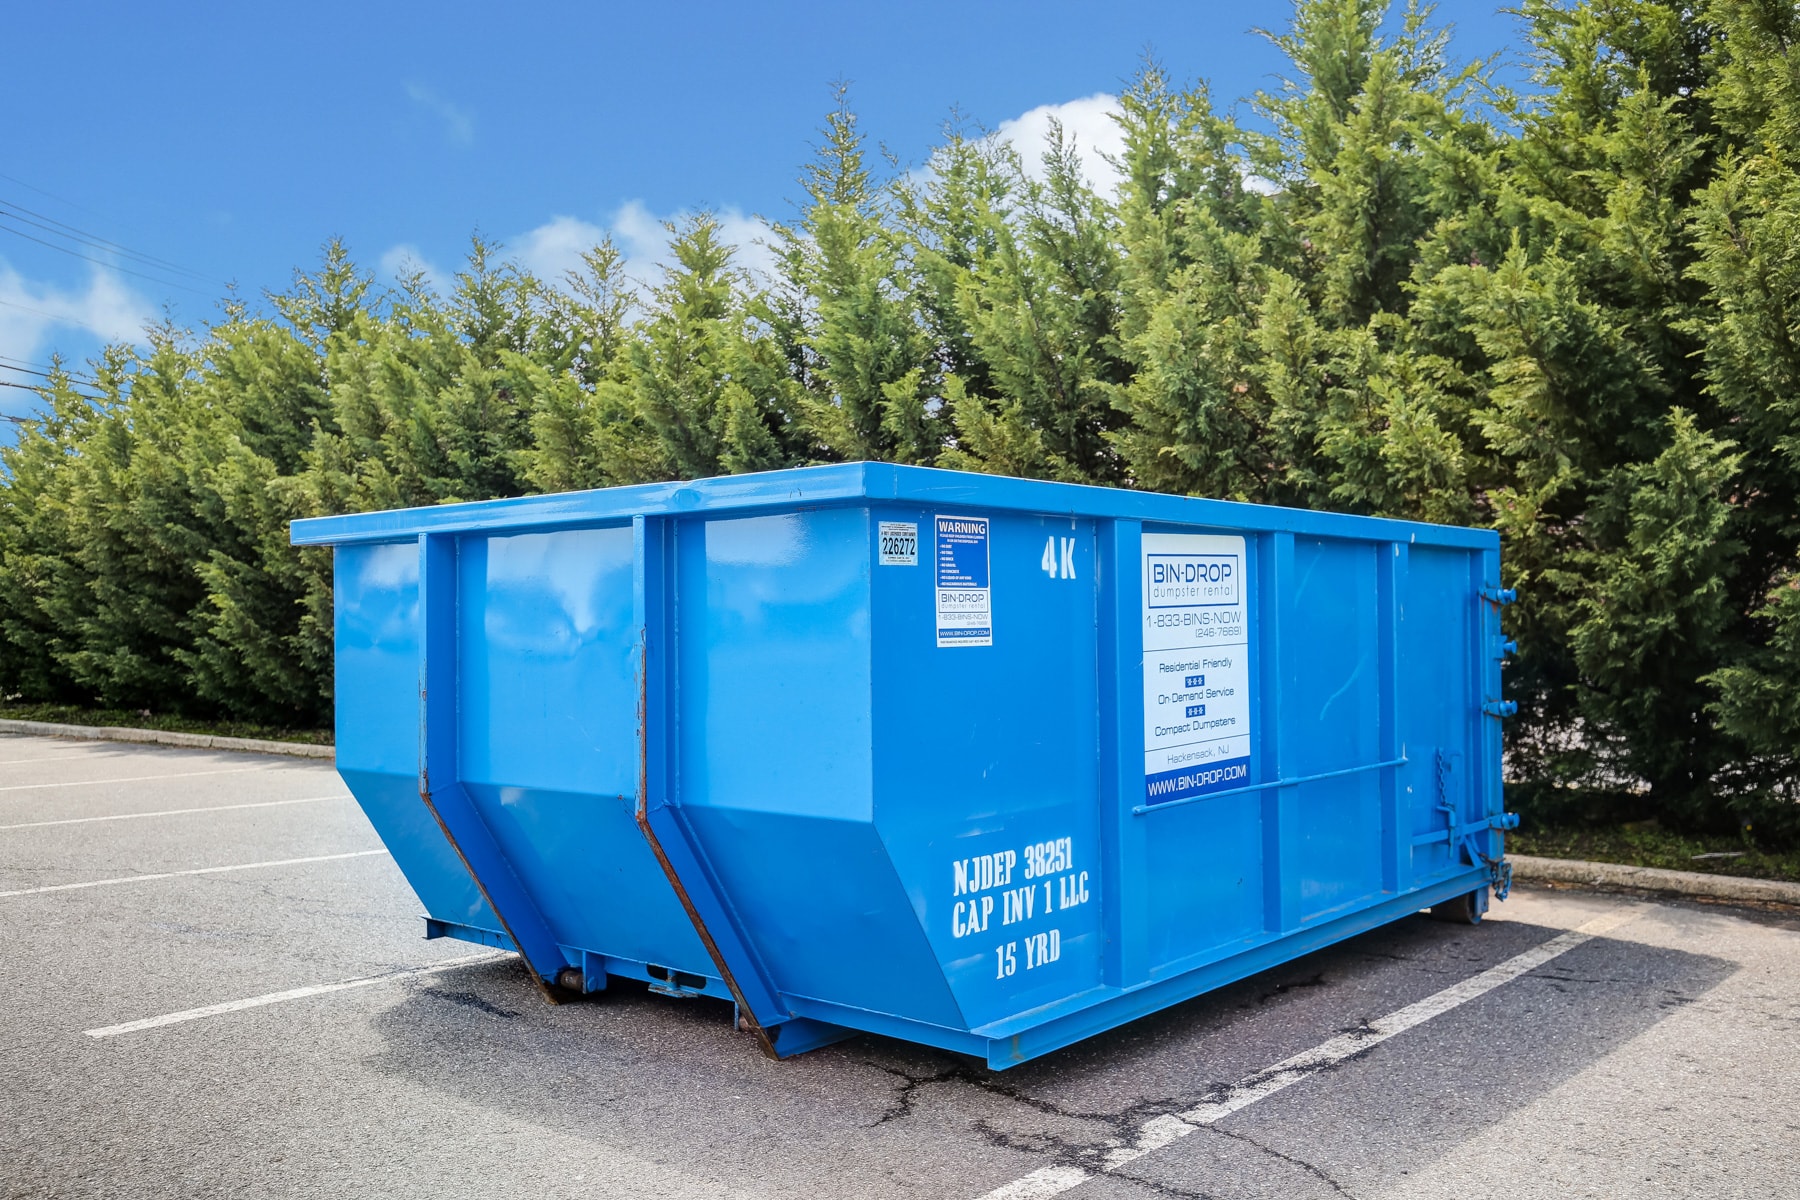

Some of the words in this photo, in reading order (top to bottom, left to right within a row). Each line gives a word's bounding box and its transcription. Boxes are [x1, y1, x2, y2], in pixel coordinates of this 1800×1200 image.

[938, 521, 986, 535] WARNING
[882, 537, 916, 556] 226272
[1153, 563, 1232, 584] BIN-DROP
[941, 593, 985, 603] BIN-DROP
[1153, 585, 1200, 600] dumpster
[1204, 583, 1233, 597] rental
[1146, 610, 1242, 628] 1-833-BINS-NOW
[1195, 626, 1242, 638] (246-7669)
[1159, 659, 1201, 674] Residential
[1202, 657, 1233, 671] Friendly
[1206, 687, 1235, 700] Service
[1154, 721, 1191, 738] Compact
[1192, 716, 1236, 732] Dumpsters
[1167, 747, 1216, 765] Hackensack,
[1218, 744, 1230, 755] NJ
[1147, 764, 1247, 797] WWW.BIN-DROP.COM
[952, 849, 1017, 897] NJDEP
[1024, 836, 1073, 880] 38251
[952, 895, 994, 939] CAP
[1002, 884, 1036, 926] INV
[1044, 880, 1053, 914] 1
[1060, 871, 1090, 910] LLC
[995, 941, 1017, 980] 15
[1025, 928, 1061, 970] YRD
